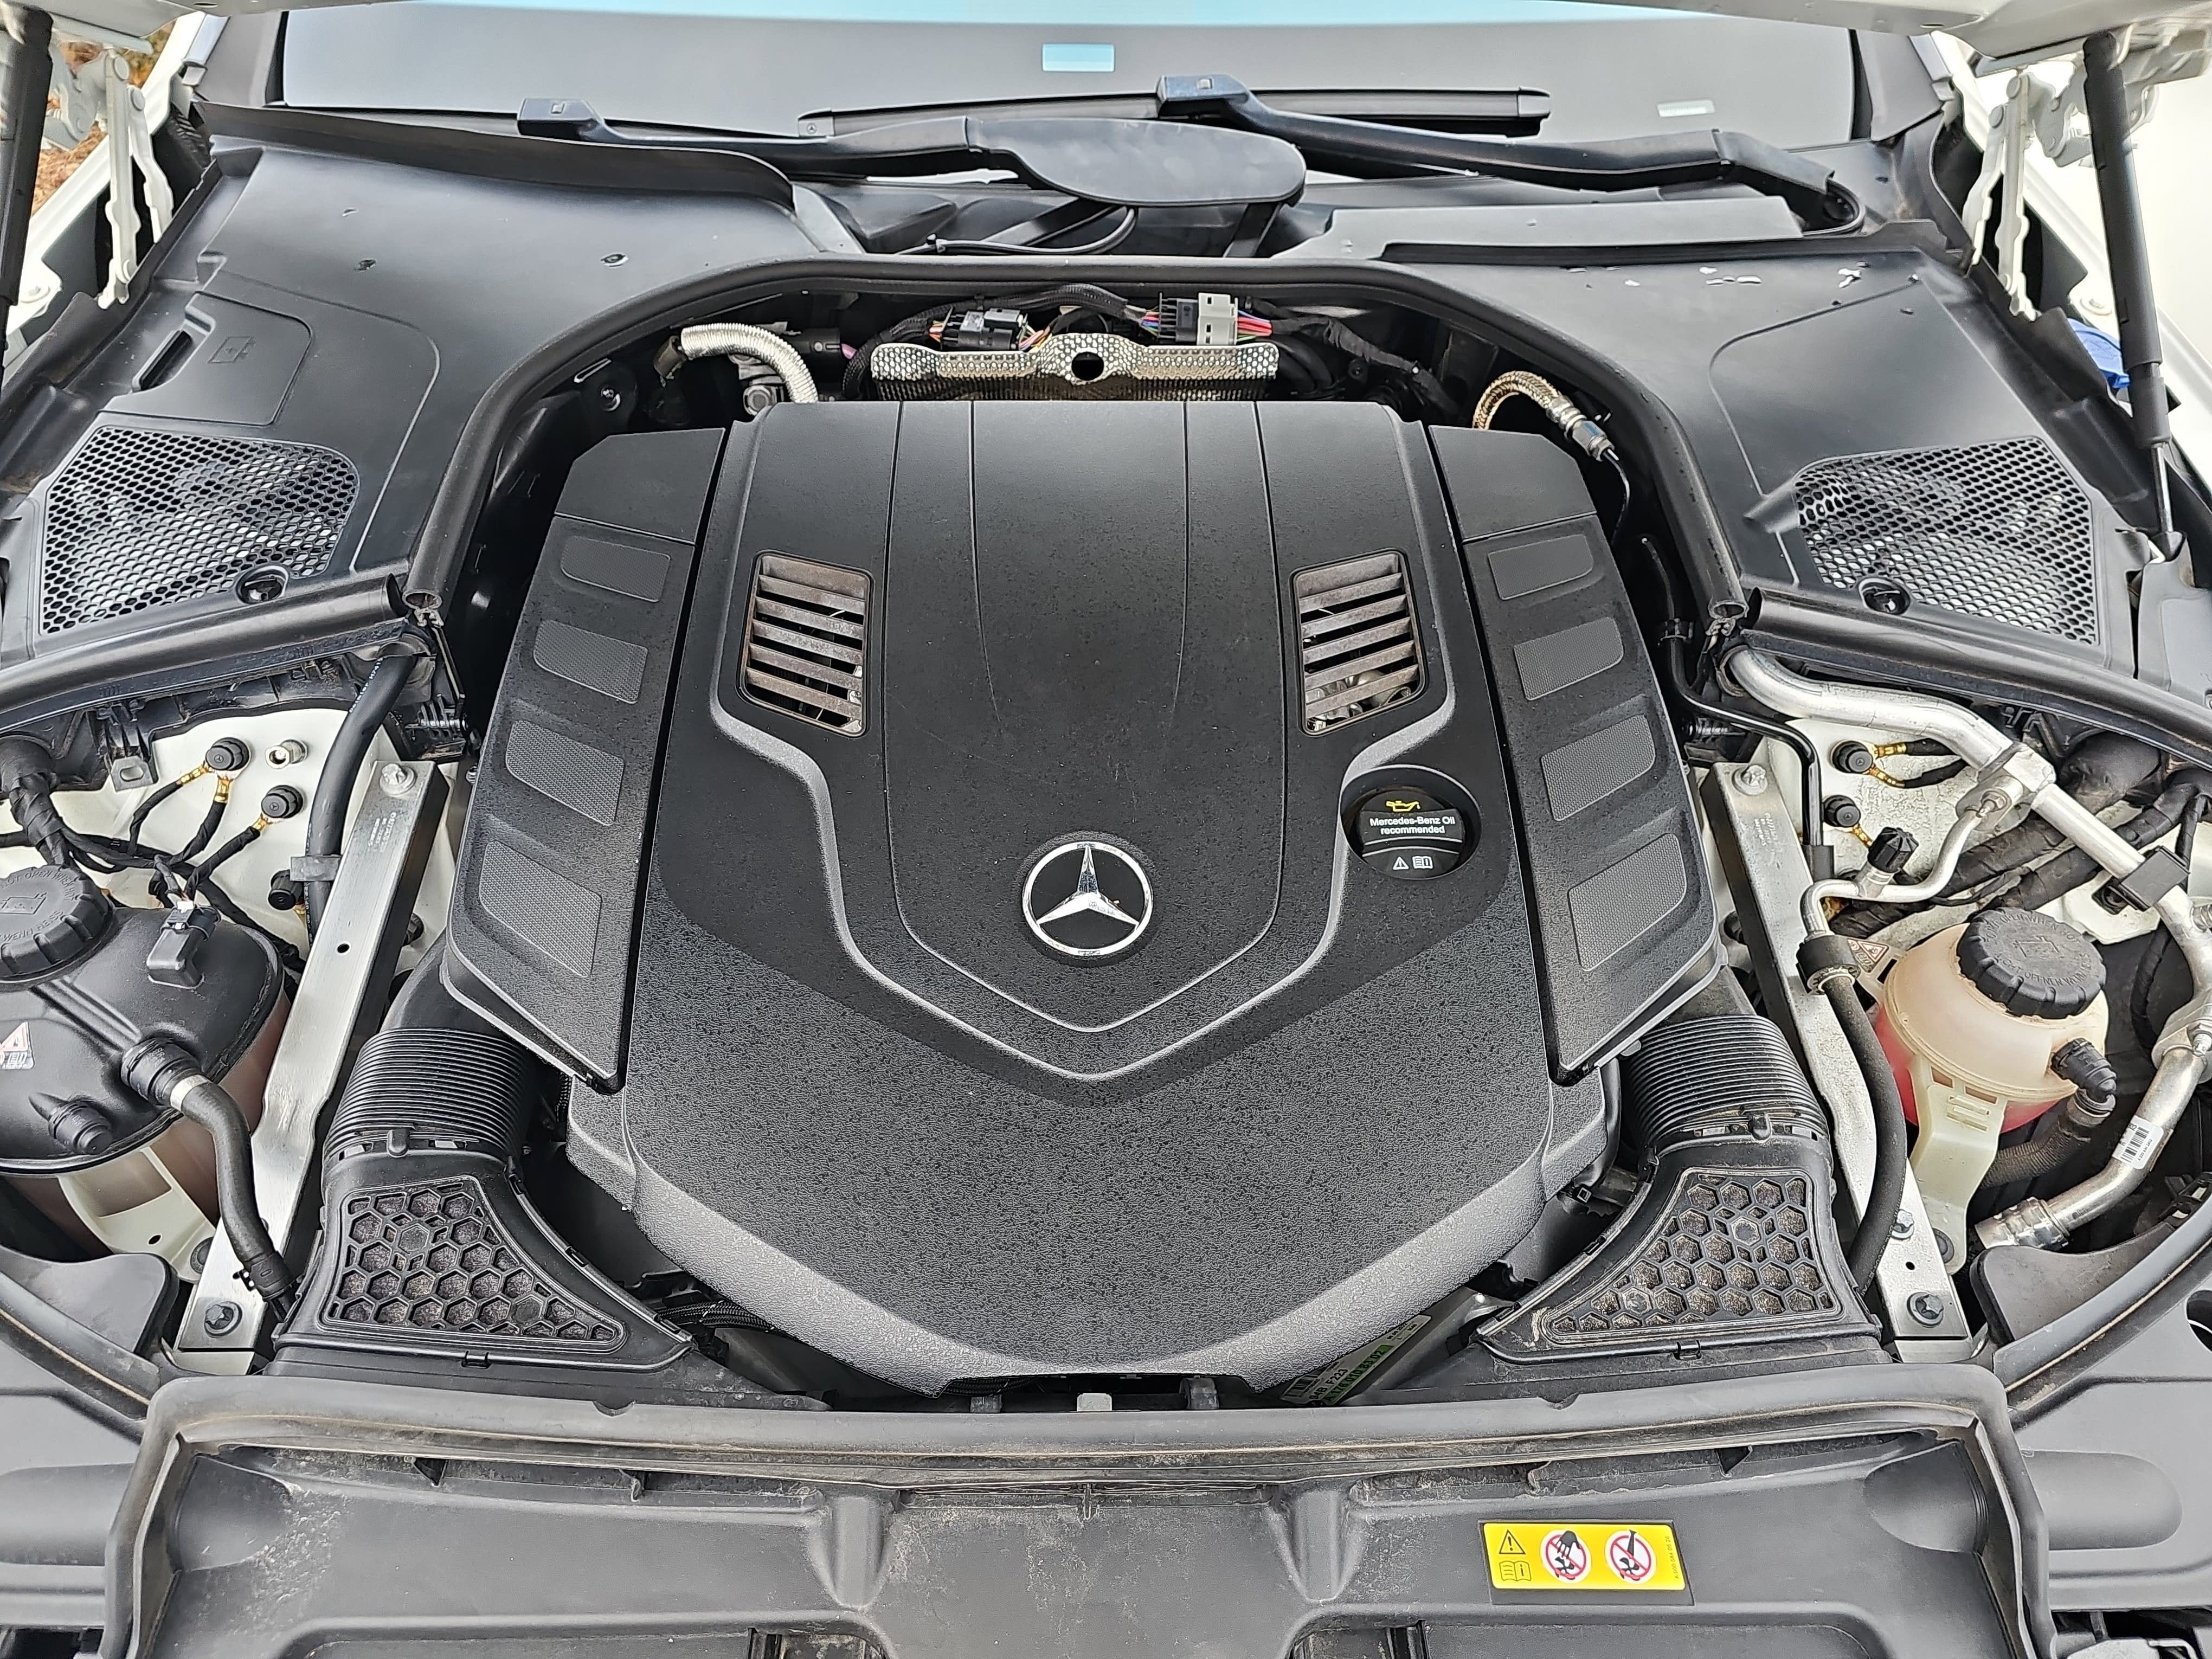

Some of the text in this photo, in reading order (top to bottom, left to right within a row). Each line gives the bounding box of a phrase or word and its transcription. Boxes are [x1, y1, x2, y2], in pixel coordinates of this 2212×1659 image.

[1369, 816, 1456, 826] Mercedes-Benz Oil
[1380, 825, 1445, 834] recommended
[1325, 1369, 1348, 1385] F223
